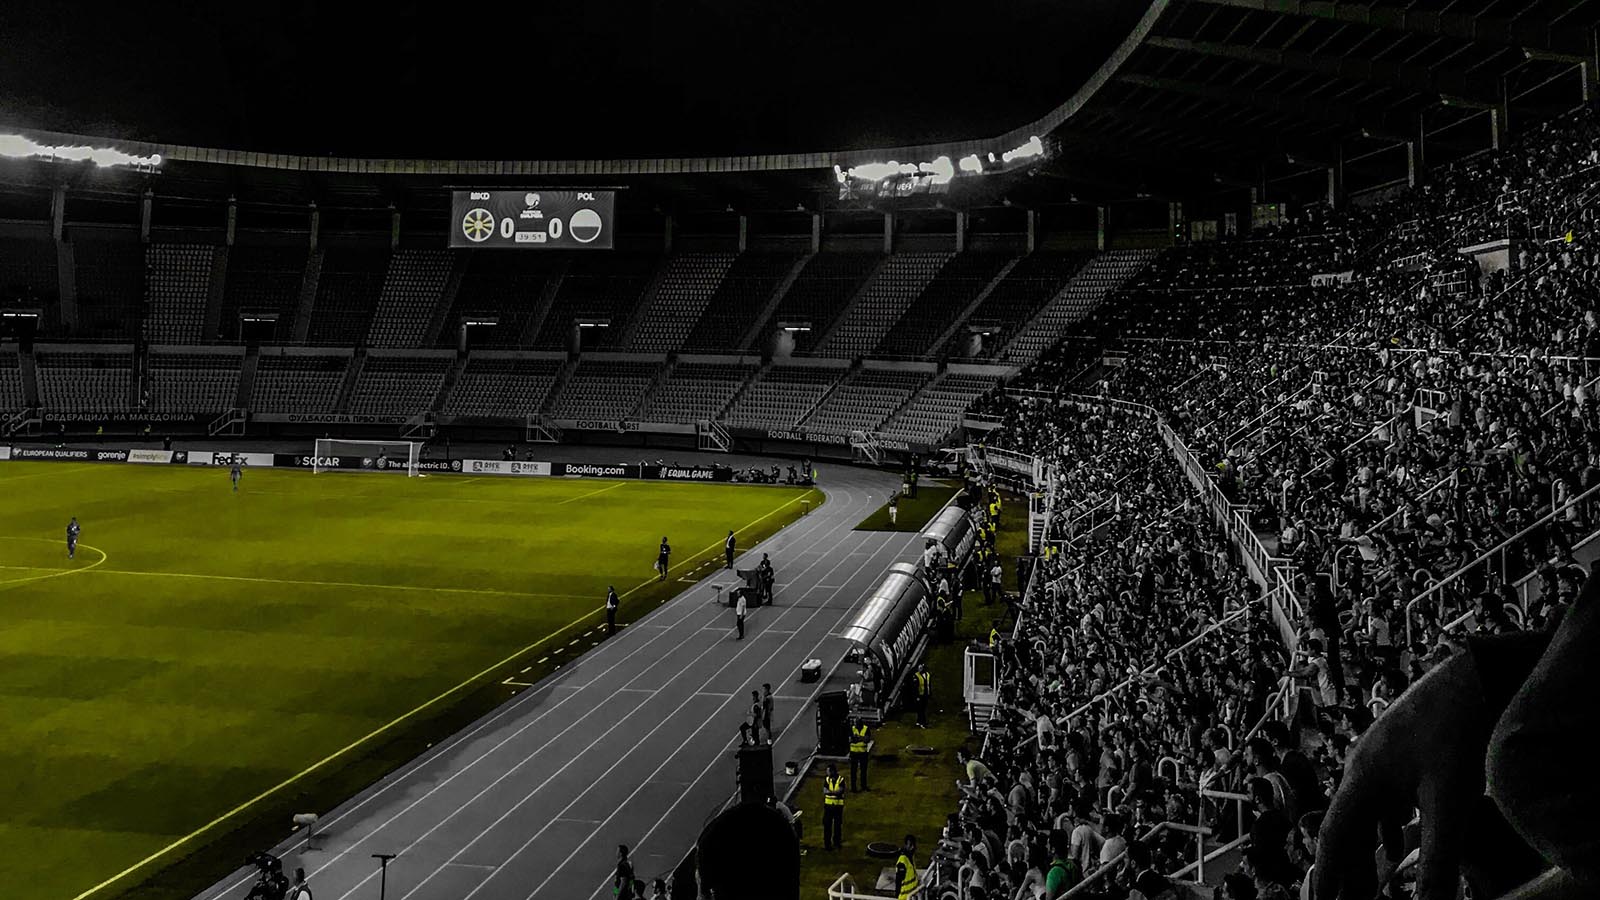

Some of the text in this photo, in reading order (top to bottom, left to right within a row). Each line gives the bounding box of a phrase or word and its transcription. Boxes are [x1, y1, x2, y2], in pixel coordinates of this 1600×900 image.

[577, 192, 595, 201] POL
[501, 218, 514, 238] 0
[549, 218, 562, 238] 0
[45, 413, 195, 422] ФЕДЕРАЦИЈА НА МАКЕДОНИЈА
[338, 415, 350, 423] НА
[378, 416, 407, 424] МЕСТО
[576, 420, 617, 430] FOOTBALL
[767, 430, 802, 440] FOOTBALL
[806, 433, 845, 444] FEDERATION
[23, 449, 88, 458] EUROPEAN QUALIFIERS
[97, 451, 126, 460] gorenje
[212, 453, 248, 466] FedEx
[302, 456, 340, 466] SOCAR
[388, 460, 401, 468] The
[566, 464, 625, 476] Booking.com
[691, 470, 714, 479] GAME
